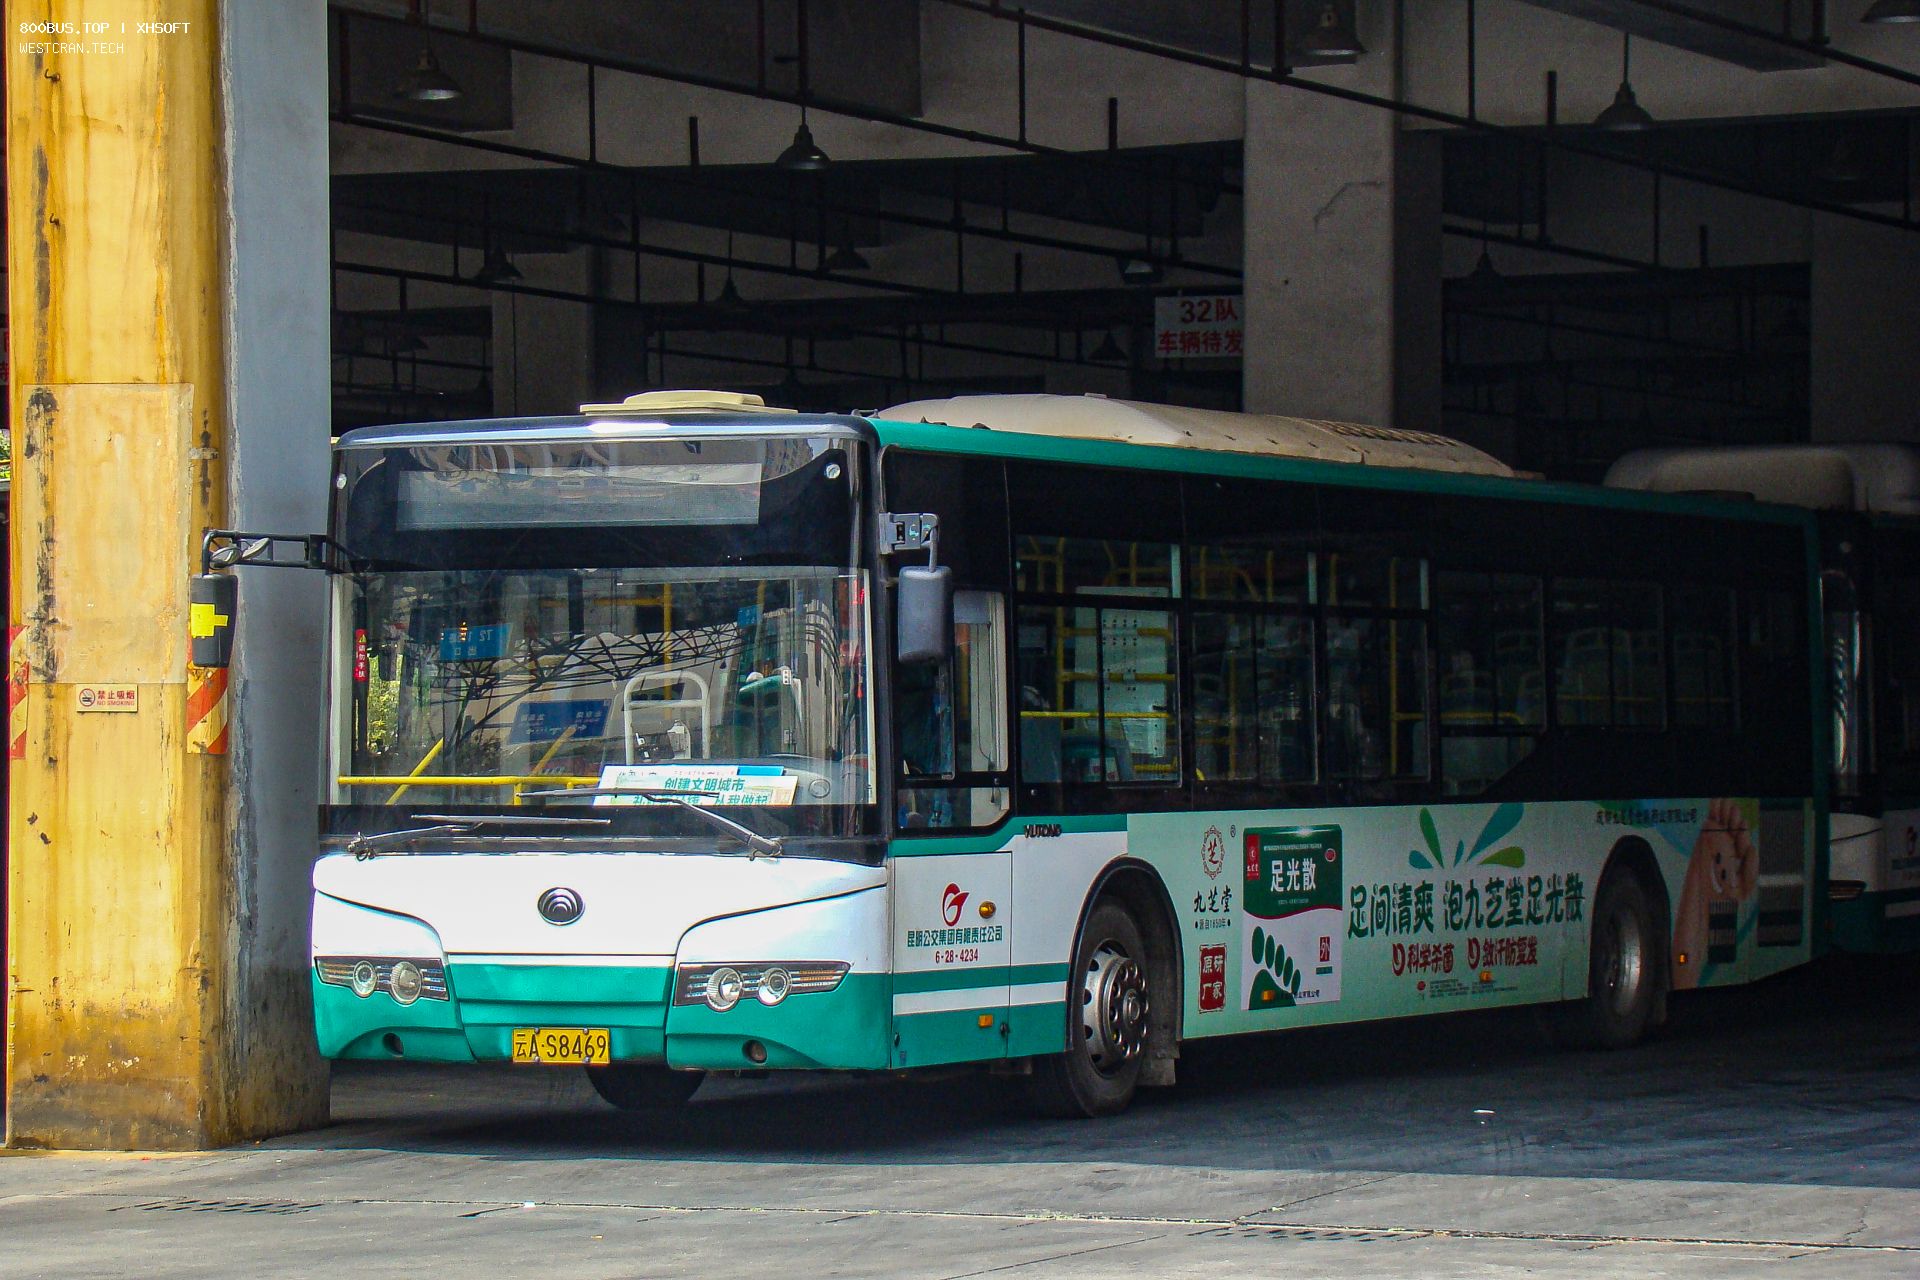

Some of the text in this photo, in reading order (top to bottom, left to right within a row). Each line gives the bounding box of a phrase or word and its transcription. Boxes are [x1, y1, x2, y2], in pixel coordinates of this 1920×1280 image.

[1180, 298, 1239, 324] 32队
[1157, 330, 1243, 354] 车辆待发
[97, 690, 135, 700] 禁止吸烟
[664, 777, 746, 792] 创建文明城市
[1270, 857, 1317, 893] 足光散
[1193, 885, 1233, 913] 九芝堂
[1347, 879, 1434, 939] 足间清爽
[907, 925, 1003, 948] 昆明公交集团有限责任公司
[1407, 942, 1455, 974] 科学杀菌
[1202, 980, 1224, 1001] 厂家
